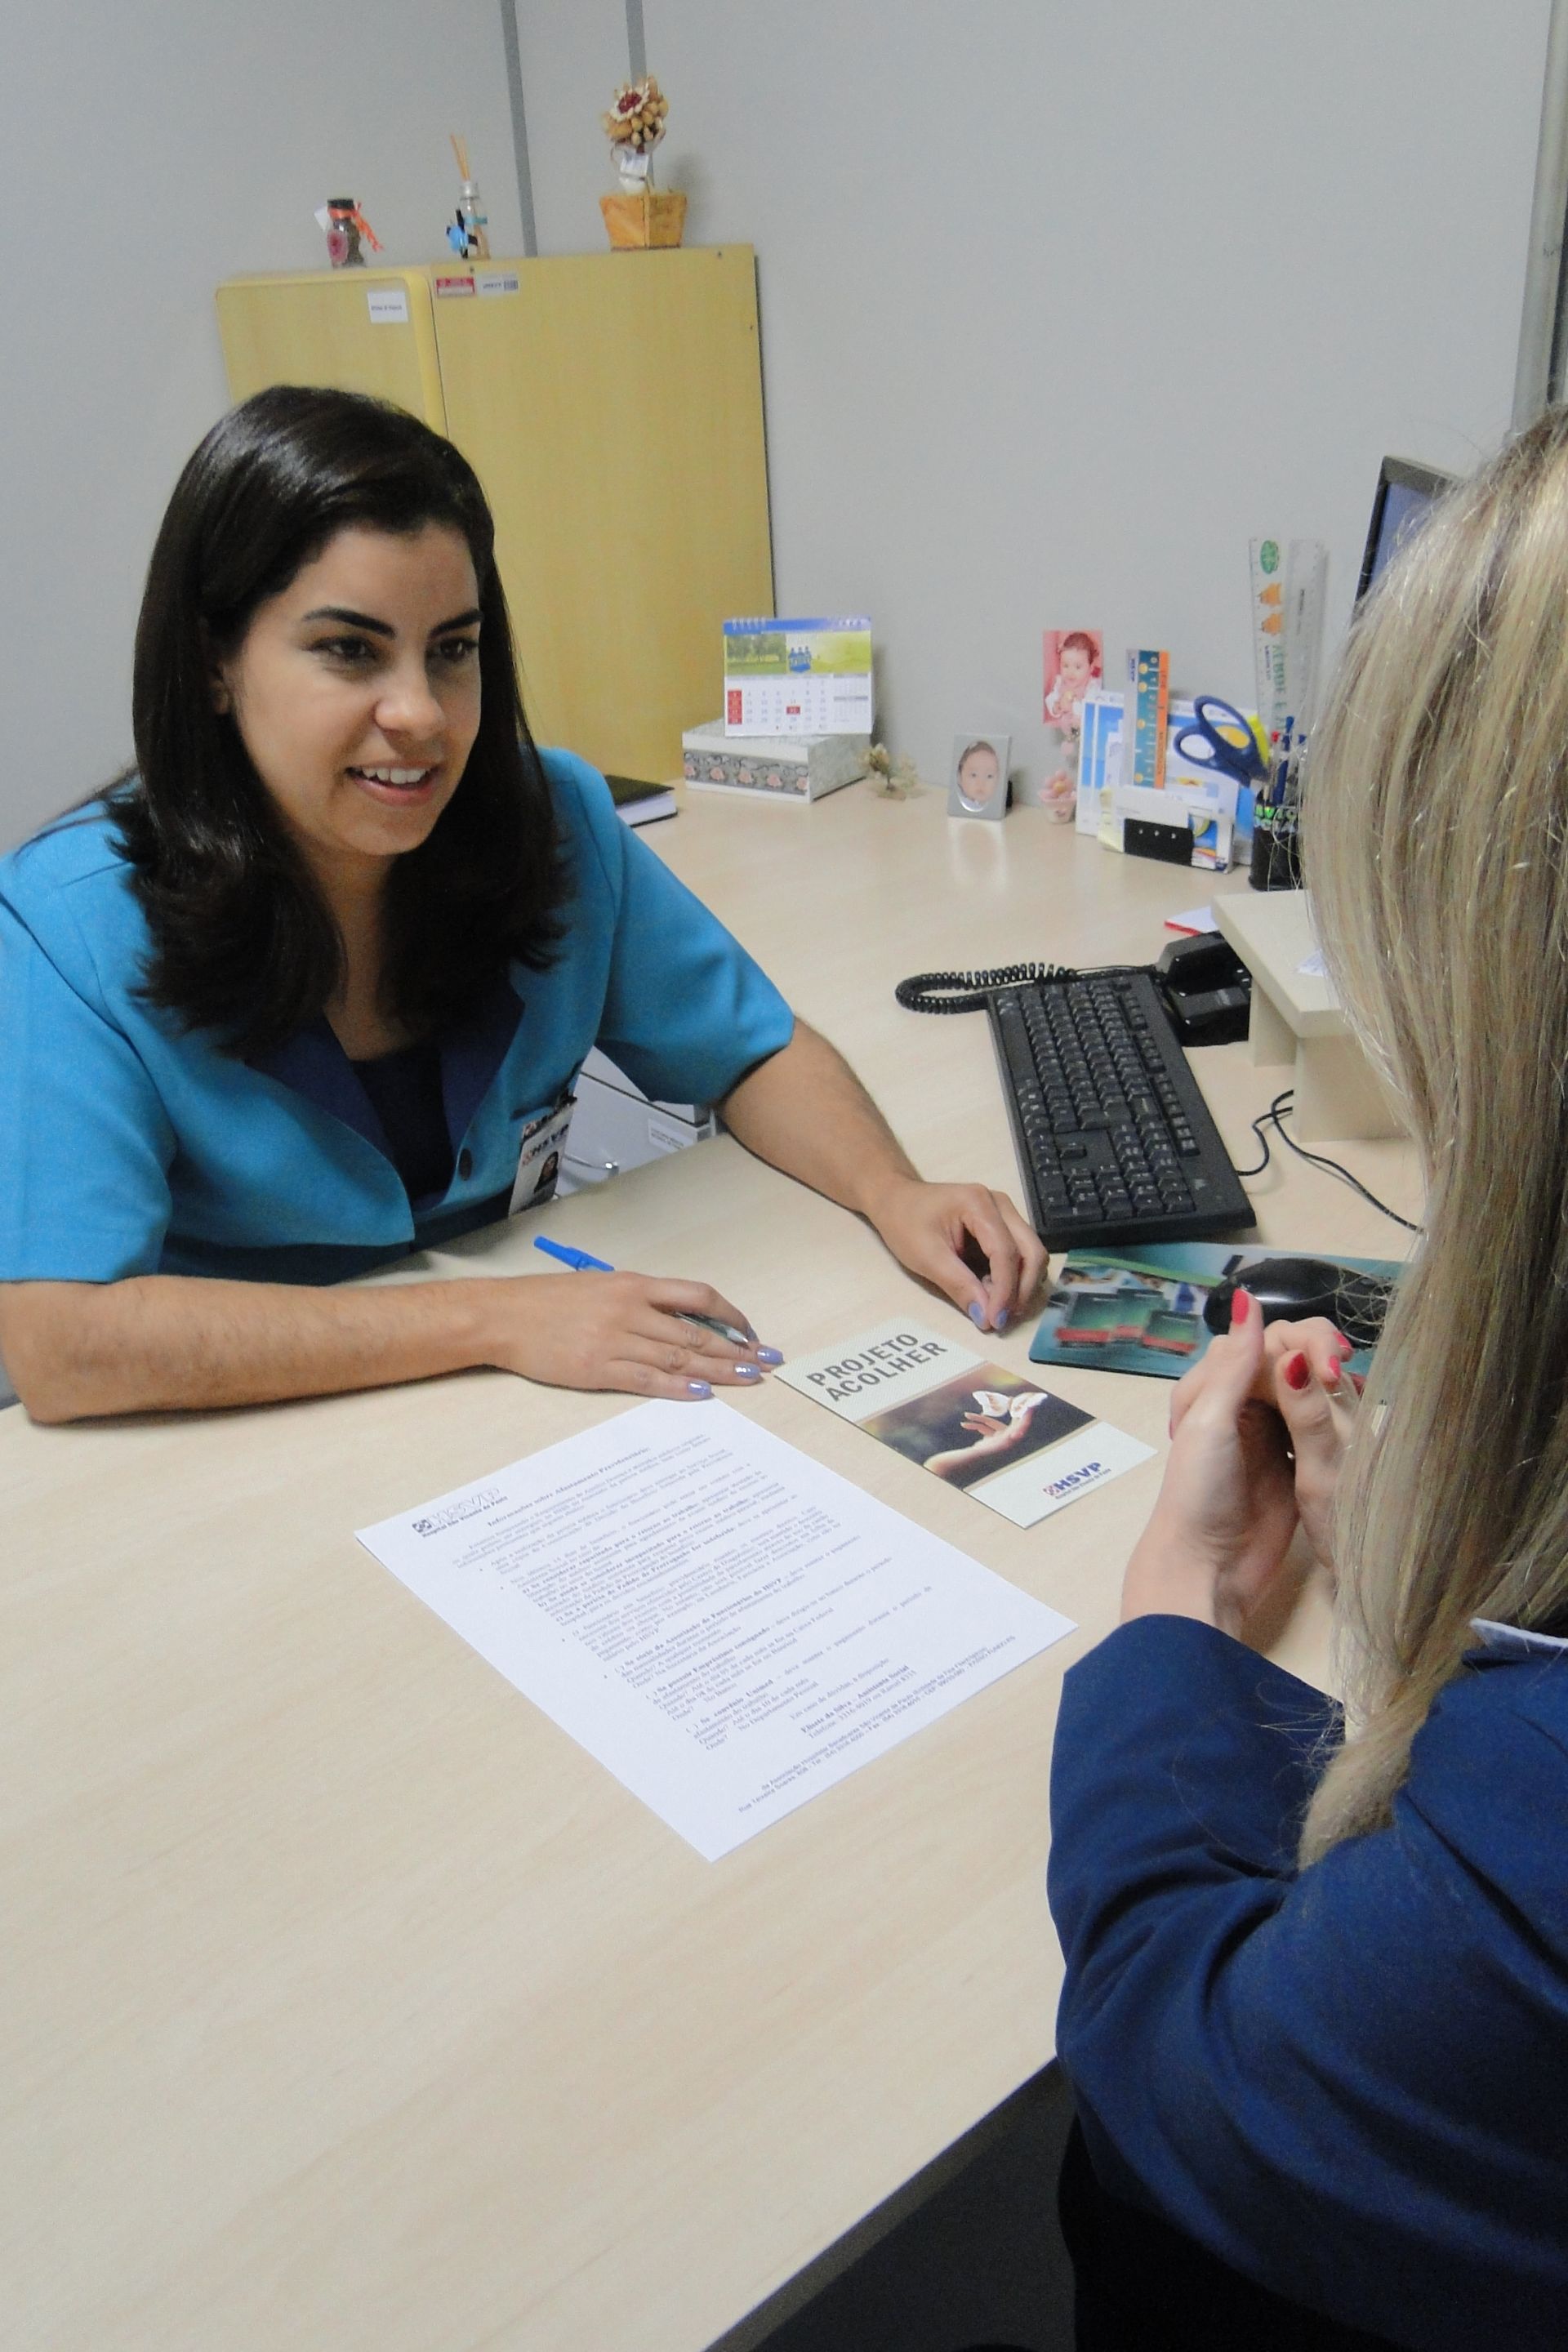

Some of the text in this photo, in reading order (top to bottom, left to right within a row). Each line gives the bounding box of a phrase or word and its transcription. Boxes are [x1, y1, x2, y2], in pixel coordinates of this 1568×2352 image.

[806, 1334, 919, 1388] PROJETO
[826, 1343, 947, 1402] ACOLHER
[1054, 1462, 1102, 1490] HSVP
